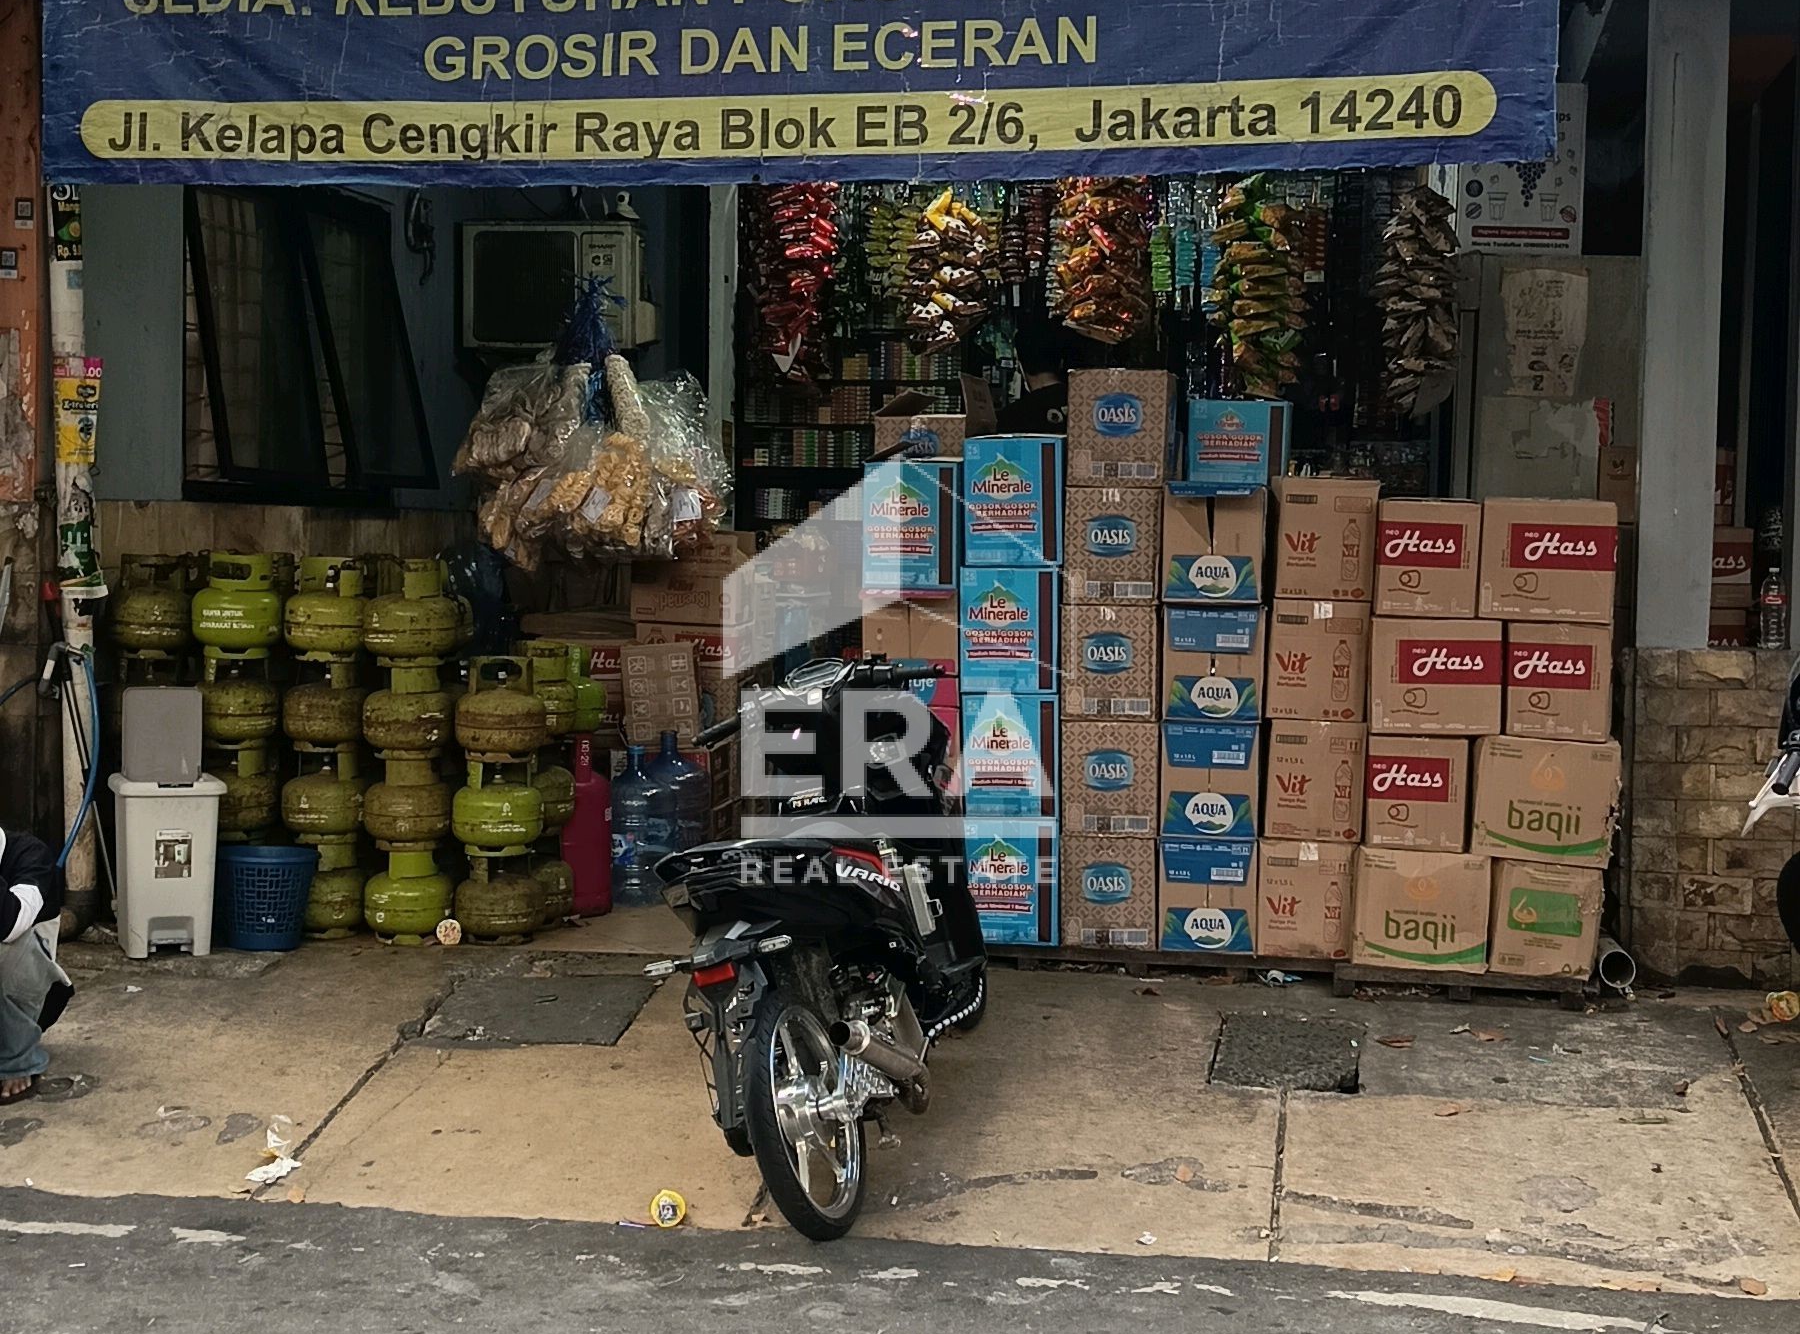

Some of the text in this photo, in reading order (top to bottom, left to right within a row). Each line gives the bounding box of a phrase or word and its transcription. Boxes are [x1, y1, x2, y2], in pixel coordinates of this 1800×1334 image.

[424, 14, 1099, 82] GROSIR DAN ECERAN
[107, 82, 1463, 163] Jl. Kelapa Cengkir Raya Blok EB 2/6, Jakarta 14240
[1098, 404, 1137, 424] OASIS
[993, 468, 1009, 481] Le
[972, 481, 1032, 494] Minerale
[892, 490, 907, 504] Le
[870, 503, 929, 516] Minerale
[1091, 528, 1131, 545] OASIS
[1285, 531, 1321, 553] Vit
[1385, 530, 1456, 558] Hass
[1524, 532, 1597, 561] Hass
[1194, 566, 1230, 581] AQUA
[990, 595, 1005, 609] Le
[969, 608, 1028, 620] Minerale
[1087, 645, 1126, 662] OASIS
[1275, 651, 1312, 674] Vit
[1412, 648, 1484, 677] Hass
[1513, 651, 1586, 680] Hass
[1197, 686, 1232, 702] AQUA
[992, 724, 1008, 737] Le
[971, 736, 1031, 749] Minerale
[1089, 763, 1128, 780] OASIS
[1373, 764, 1443, 792] Hass
[1276, 773, 1312, 796] Vit
[1191, 803, 1227, 818] AQUA
[1507, 800, 1581, 842] baqii
[991, 848, 1006, 862] Le
[969, 861, 1028, 874] Minerale
[835, 862, 901, 892] VARIO
[1087, 877, 1126, 893] OASIS
[1266, 894, 1302, 917] Vit
[1190, 918, 1225, 932] AQUA
[1384, 910, 1456, 950] baqii
